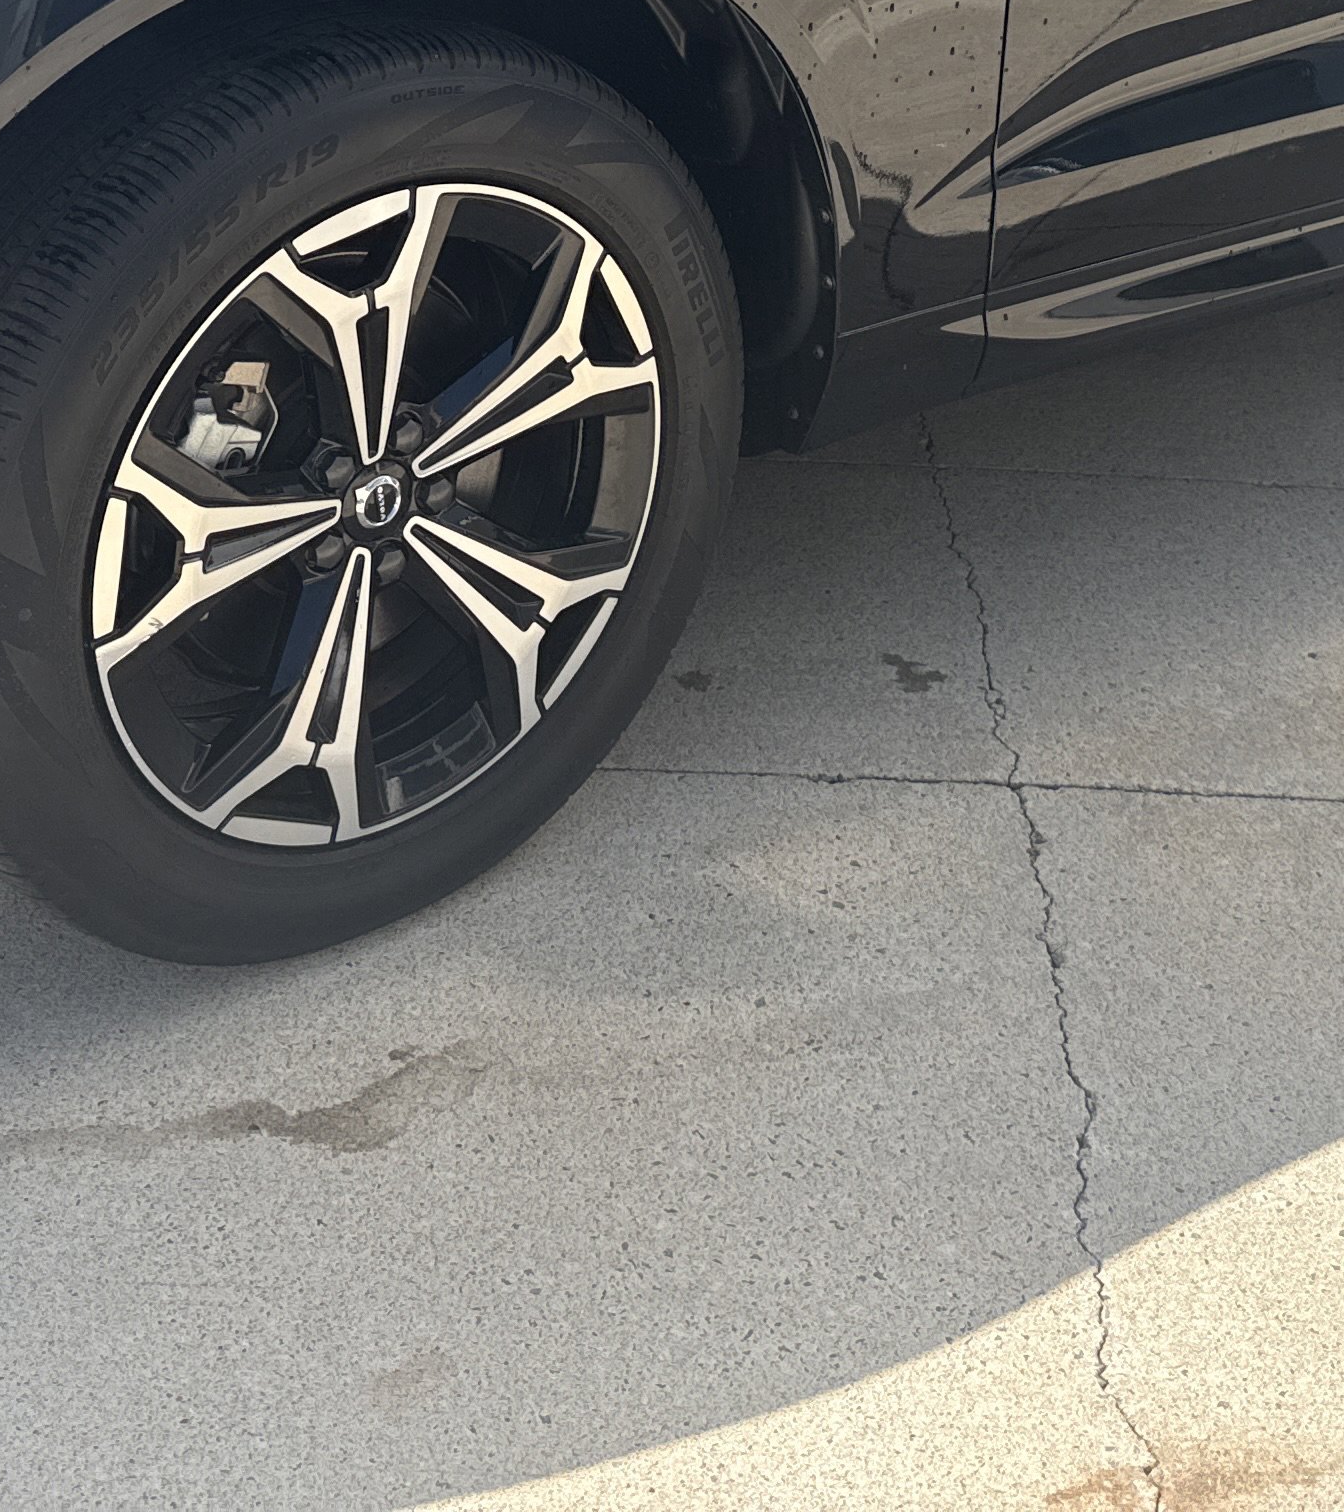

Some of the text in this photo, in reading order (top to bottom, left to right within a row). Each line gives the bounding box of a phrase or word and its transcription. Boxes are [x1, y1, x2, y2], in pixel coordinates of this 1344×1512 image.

[390, 84, 467, 104] OUTSIDE
[89, 195, 241, 387] 235/55
[254, 133, 341, 204] R19
[664, 209, 727, 368] PIRELLI
